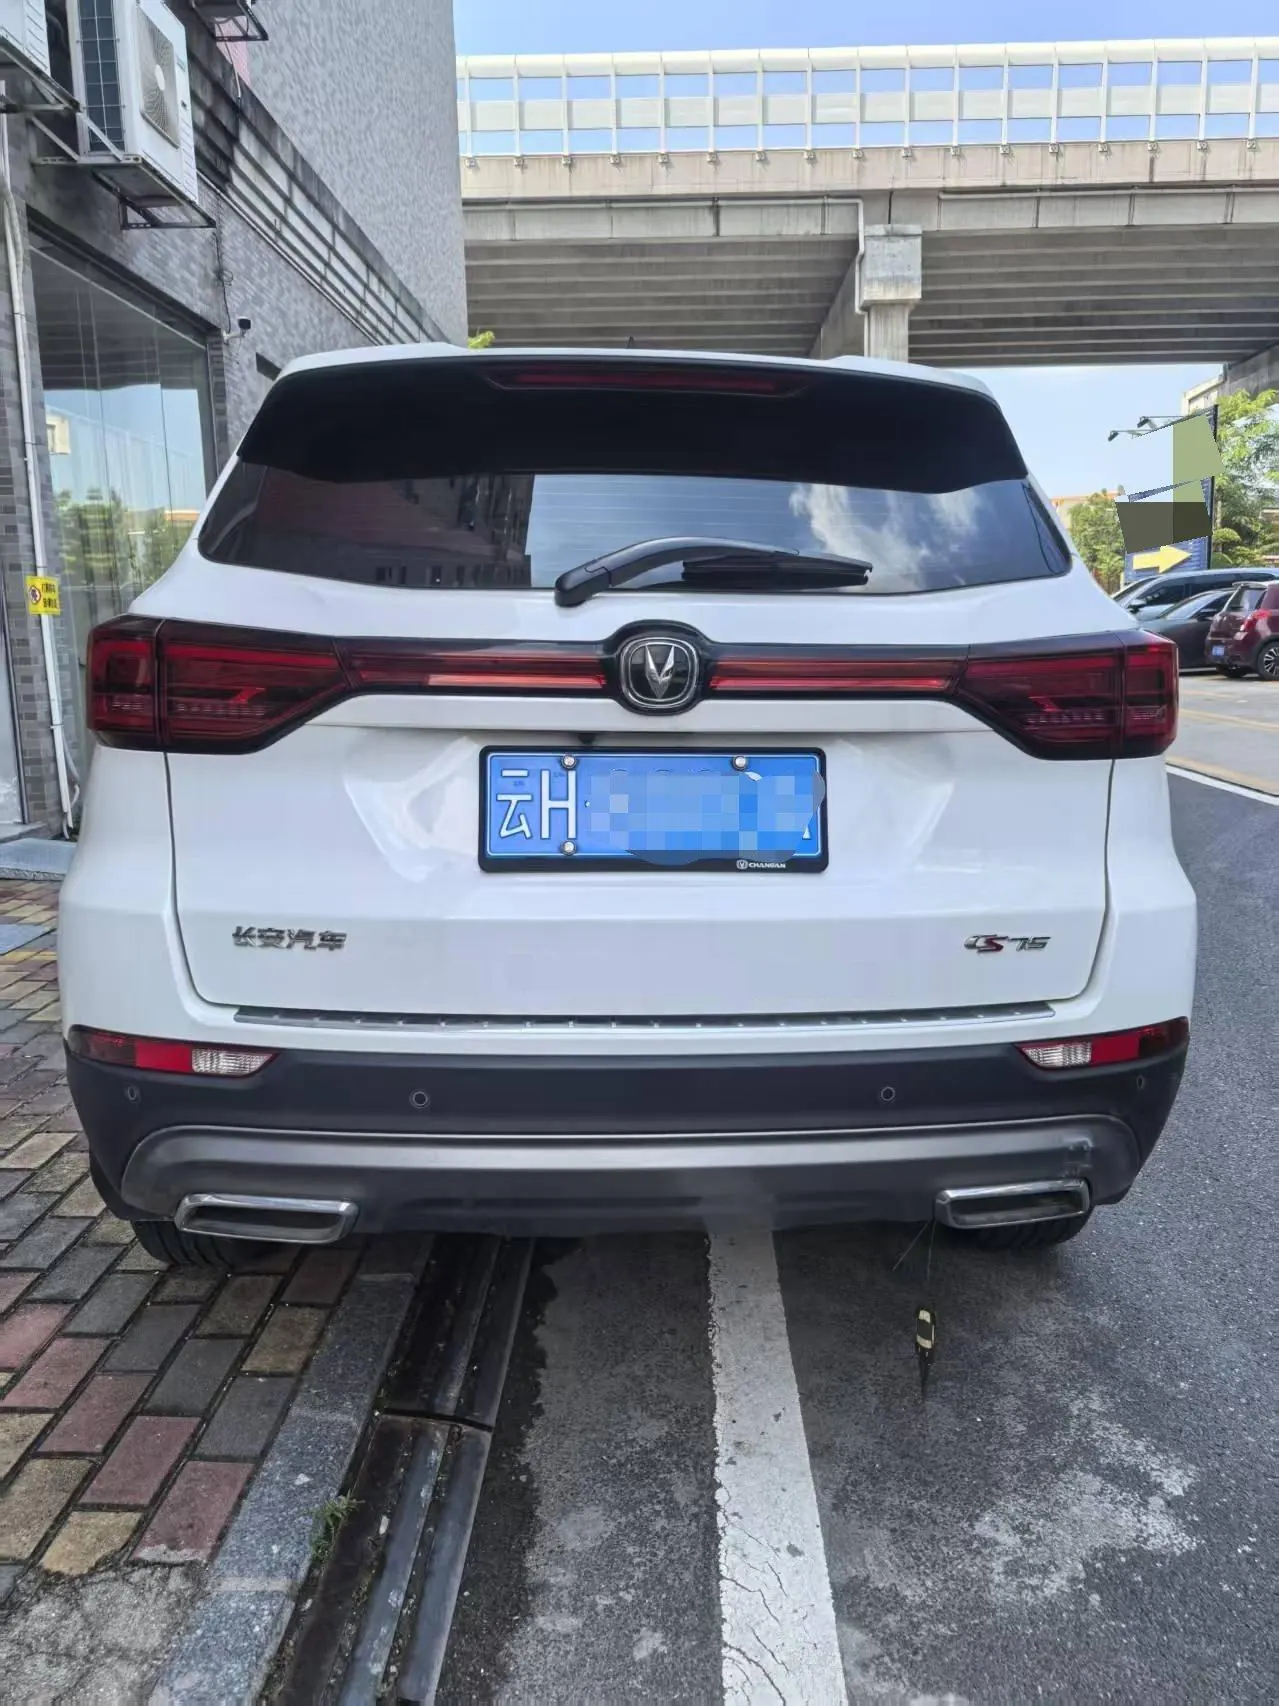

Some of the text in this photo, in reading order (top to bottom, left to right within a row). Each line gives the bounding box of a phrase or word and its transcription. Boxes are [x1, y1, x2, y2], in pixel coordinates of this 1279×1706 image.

[231, 926, 347, 951] 长安汽车
[963, 934, 1051, 953] CS75
